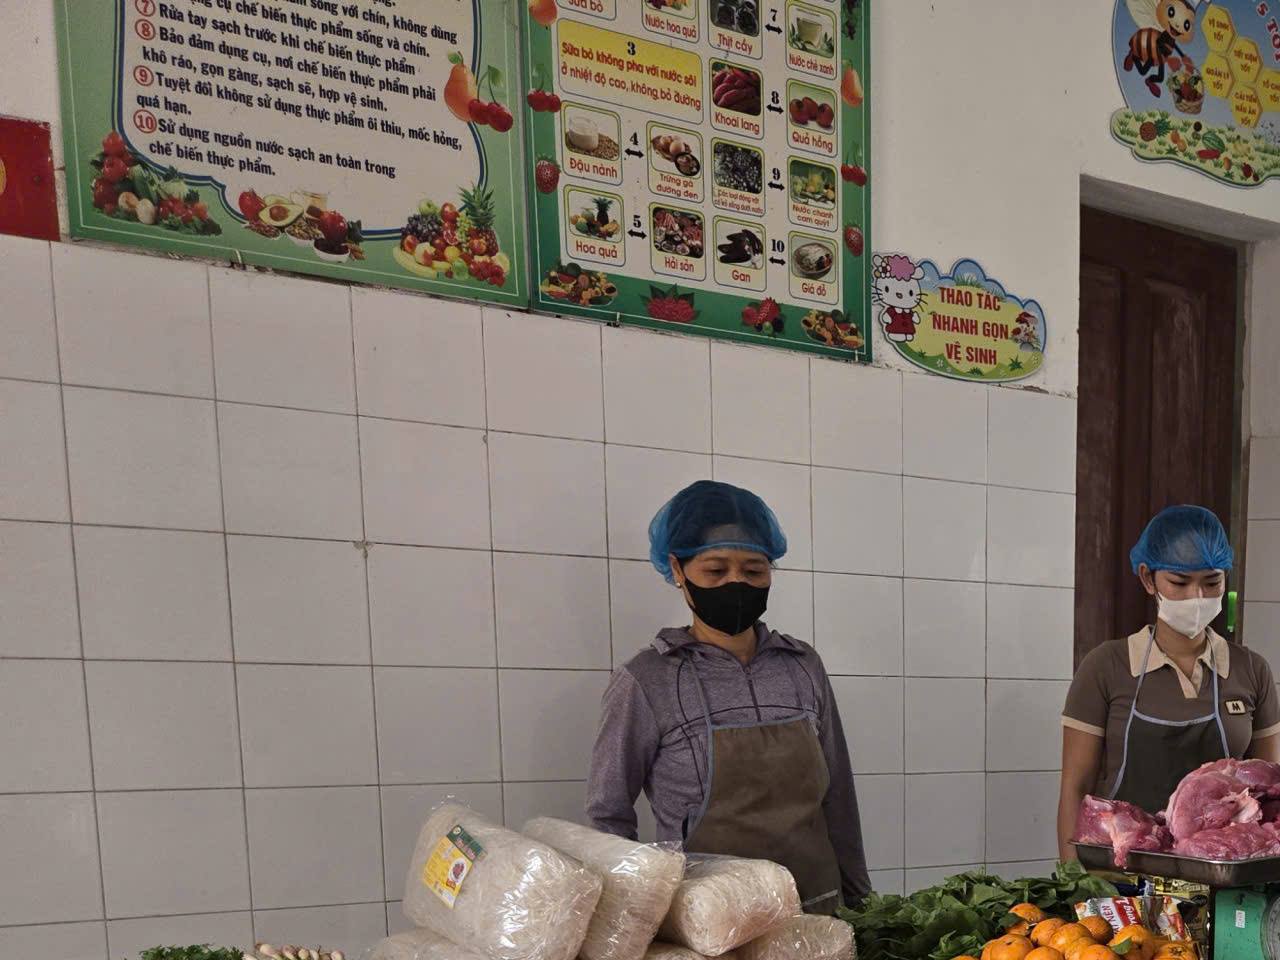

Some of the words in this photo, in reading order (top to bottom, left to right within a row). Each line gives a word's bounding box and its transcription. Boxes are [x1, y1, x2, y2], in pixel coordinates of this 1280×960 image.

[342, 4, 358, 18] với
[362, 9, 390, 28] chín,
[393, 15, 428, 37] không
[431, 25, 458, 44] dùng
[645, 14, 665, 29] Nước
[666, 22, 681, 34] hoa
[682, 24, 697, 38] quả
[770, 8, 778, 22] 7
[160, 4, 184, 22] Rửa
[188, 11, 207, 28] tay
[212, 18, 241, 36] sạch
[245, 23, 277, 44] trước
[281, 32, 300, 48] khi
[304, 39, 326, 54] chế
[328, 44, 352, 61] biến
[356, 50, 382, 68] thực
[385, 57, 416, 75] phẩm
[236, 2, 258, 16] chế
[262, 5, 288, 24] biến
[291, 12, 317, 32] thực
[322, 20, 352, 39] phẩm
[356, 28, 383, 48] sống
[387, 36, 400, 50] và
[404, 40, 430, 58] chín.
[627, 42, 636, 56] 3
[718, 33, 733, 50] Thịt
[160, 26, 185, 44] Bảo
[188, 33, 214, 52] đảm
[219, 41, 249, 62] dụng
[253, 50, 271, 68] cụ,
[276, 56, 294, 70] nơi
[298, 60, 319, 74] chế
[322, 64, 346, 81] biến
[350, 70, 376, 89] thực
[379, 77, 409, 94] phẩm
[413, 85, 436, 101] phải
[562, 42, 580, 57] Sữa
[582, 48, 594, 60] bò
[596, 49, 624, 72] không
[626, 60, 644, 74] pha
[646, 64, 660, 78] với
[660, 69, 682, 84] nước
[684, 74, 697, 88] sôi
[142, 46, 167, 64] khô
[172, 54, 198, 72] ráo,
[201, 62, 225, 78] gọn
[228, 68, 262, 88] gàng,
[267, 76, 294, 92] sạch
[319, 84, 340, 103] hợp
[344, 92, 358, 108] vệ
[360, 96, 388, 112] sinh.
[570, 66, 592, 84] nhiệt
[594, 72, 606, 88] độ
[608, 77, 629, 92] cao,
[630, 80, 658, 100] không
[674, 91, 702, 112] đường
[136, 94, 160, 108] quá
[164, 96, 192, 115] hạn.
[772, 91, 780, 104] 8
[156, 72, 191, 94] Tuyệt
[216, 86, 254, 107] không
[258, 94, 272, 108] sử
[275, 98, 302, 118] dụng
[306, 104, 331, 122] thực
[334, 110, 364, 128] phẩm
[368, 117, 378, 130] ôi
[381, 120, 405, 139] thiu,
[408, 127, 430, 142] mốc
[434, 130, 463, 150] hỏng,
[715, 112, 740, 128] Khoai
[741, 120, 760, 136] lang
[138, 114, 152, 130] 10
[158, 118, 175, 134] Sử
[179, 123, 210, 143] dụng
[214, 132, 251, 150] nguồn
[256, 140, 284, 155] nước
[288, 146, 315, 162] sạch
[319, 153, 332, 165] an
[336, 153, 361, 170] toàn
[365, 159, 396, 178] trong
[630, 132, 638, 146] 4
[792, 132, 810, 146] Quả
[150, 141, 174, 156] chế
[176, 144, 203, 162] biến
[207, 150, 234, 170] thực
[239, 156, 276, 176] phẩm.
[570, 157, 590, 174] Đậu
[592, 164, 618, 178] nành
[772, 168, 780, 180] 9
[632, 214, 642, 228] 5
[576, 240, 596, 254] Hoa
[598, 245, 618, 260] quả
[772, 239, 785, 252] 10
[664, 256, 679, 270] Hải
[680, 260, 694, 272] sản
[732, 270, 750, 282] Gan
[802, 282, 816, 295] Giá
[940, 286, 973, 307] THAO
[977, 290, 1001, 312] TÁC
[932, 313, 978, 336] NHANH
[982, 321, 1008, 342] GỌN
[946, 340, 961, 364] VỆ
[966, 346, 997, 366] SINH
